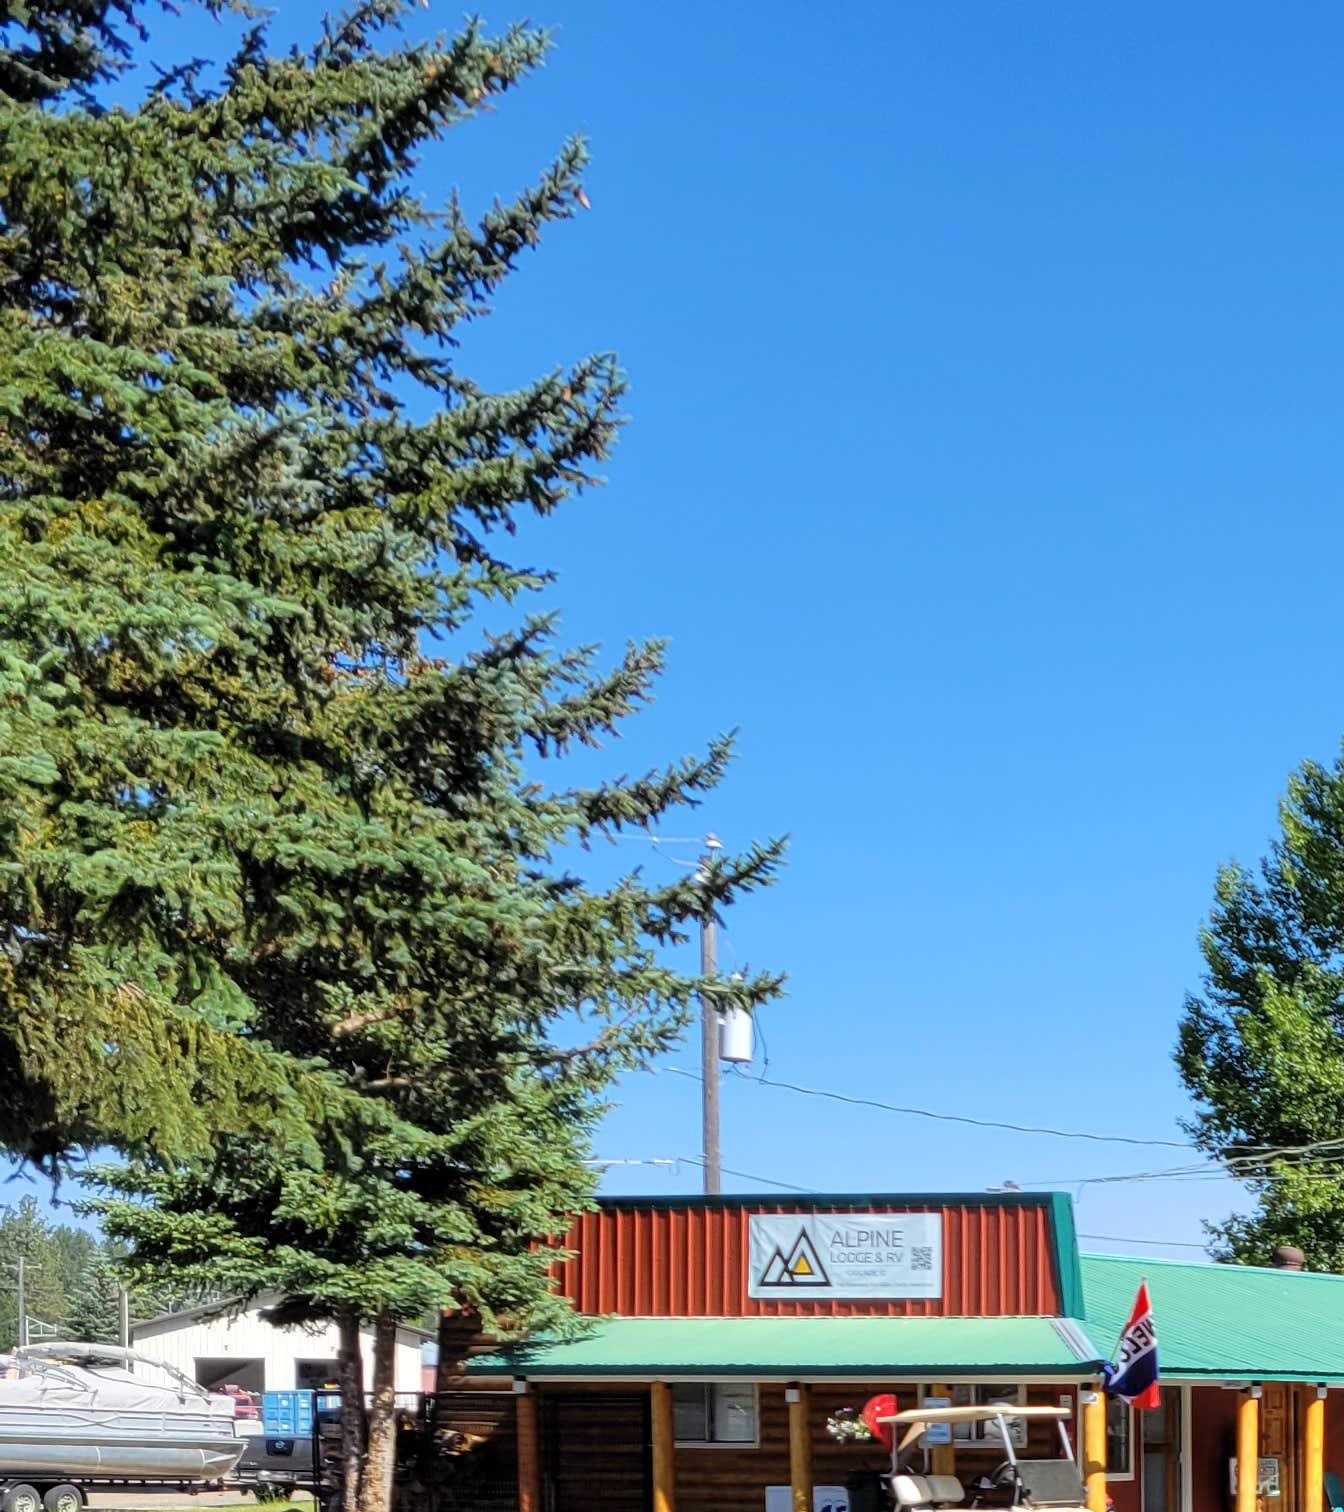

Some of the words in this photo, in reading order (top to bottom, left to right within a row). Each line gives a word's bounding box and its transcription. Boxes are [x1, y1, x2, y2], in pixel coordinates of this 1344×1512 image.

[830, 1230, 904, 1248] ALPINE
[830, 1252, 873, 1263] LODGE
[875, 1252, 883, 1263] &
[886, 1252, 903, 1263] RV
